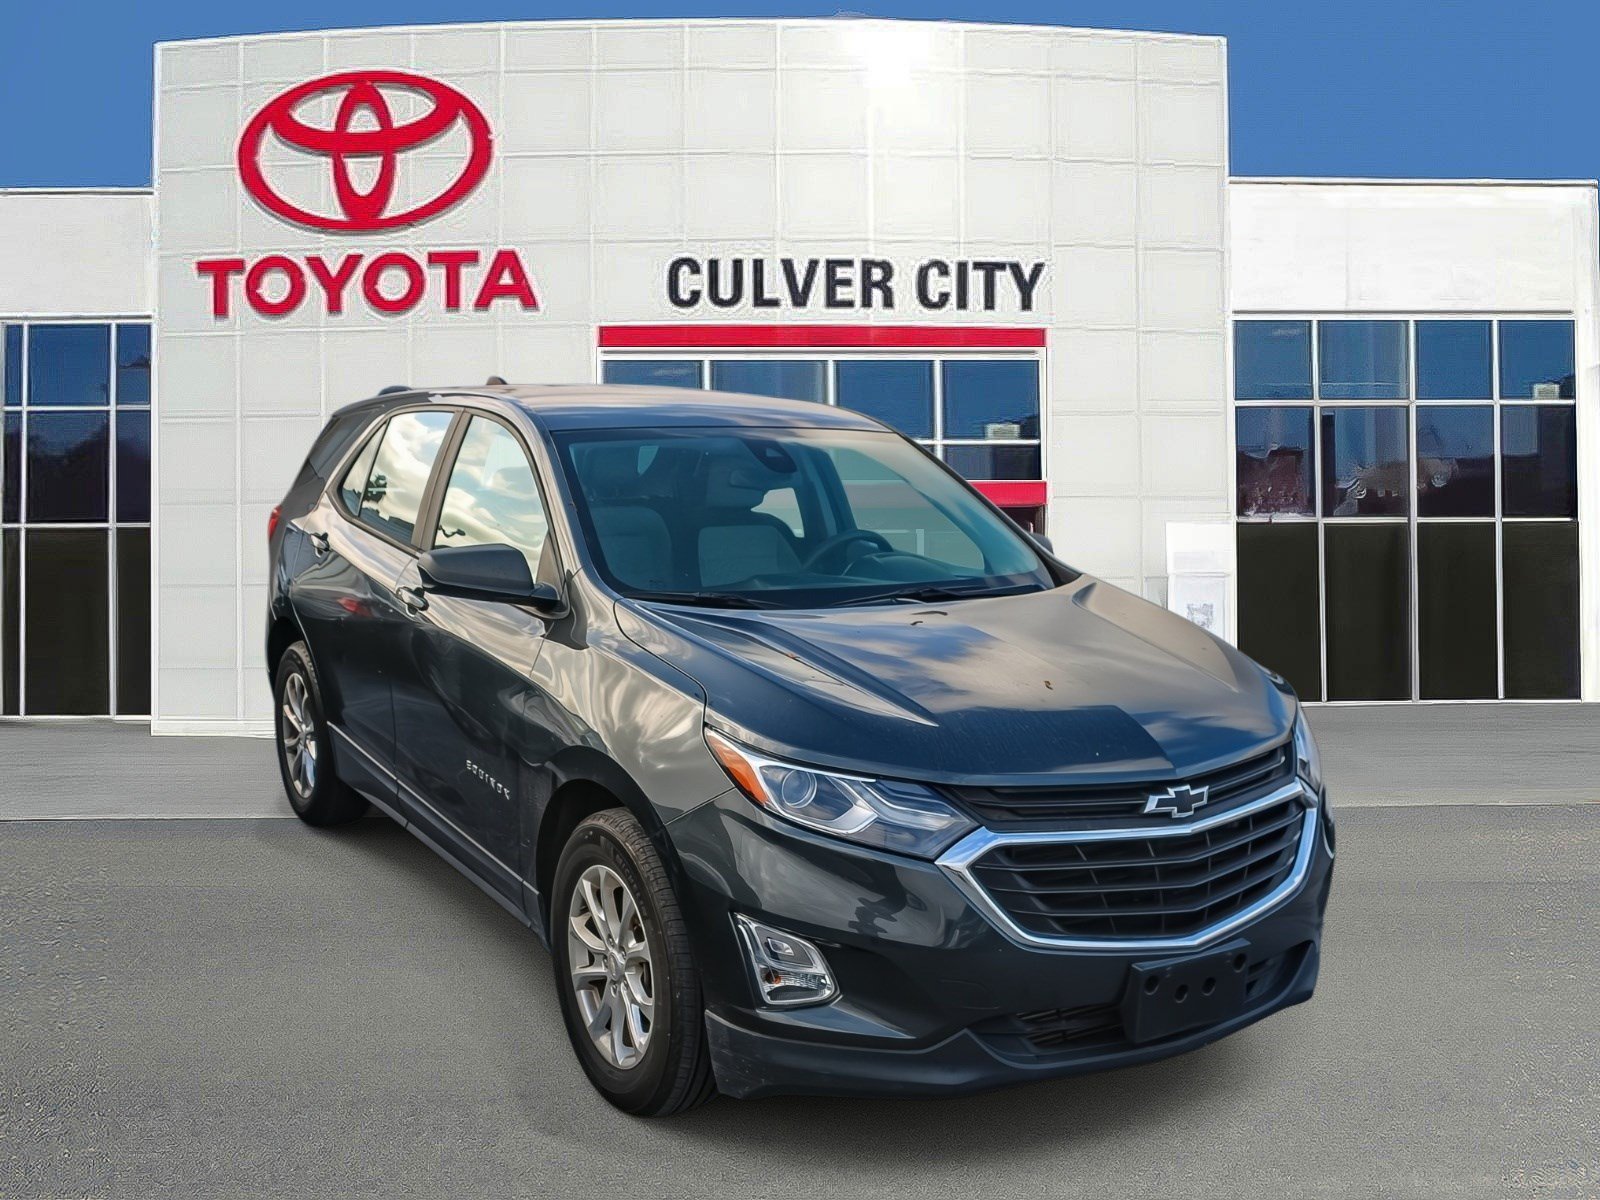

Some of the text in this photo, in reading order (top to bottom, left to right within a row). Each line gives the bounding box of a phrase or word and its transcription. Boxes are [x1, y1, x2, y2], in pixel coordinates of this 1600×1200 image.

[196, 249, 539, 318] TOYOTA
[667, 257, 1046, 311] CULVER CITY
